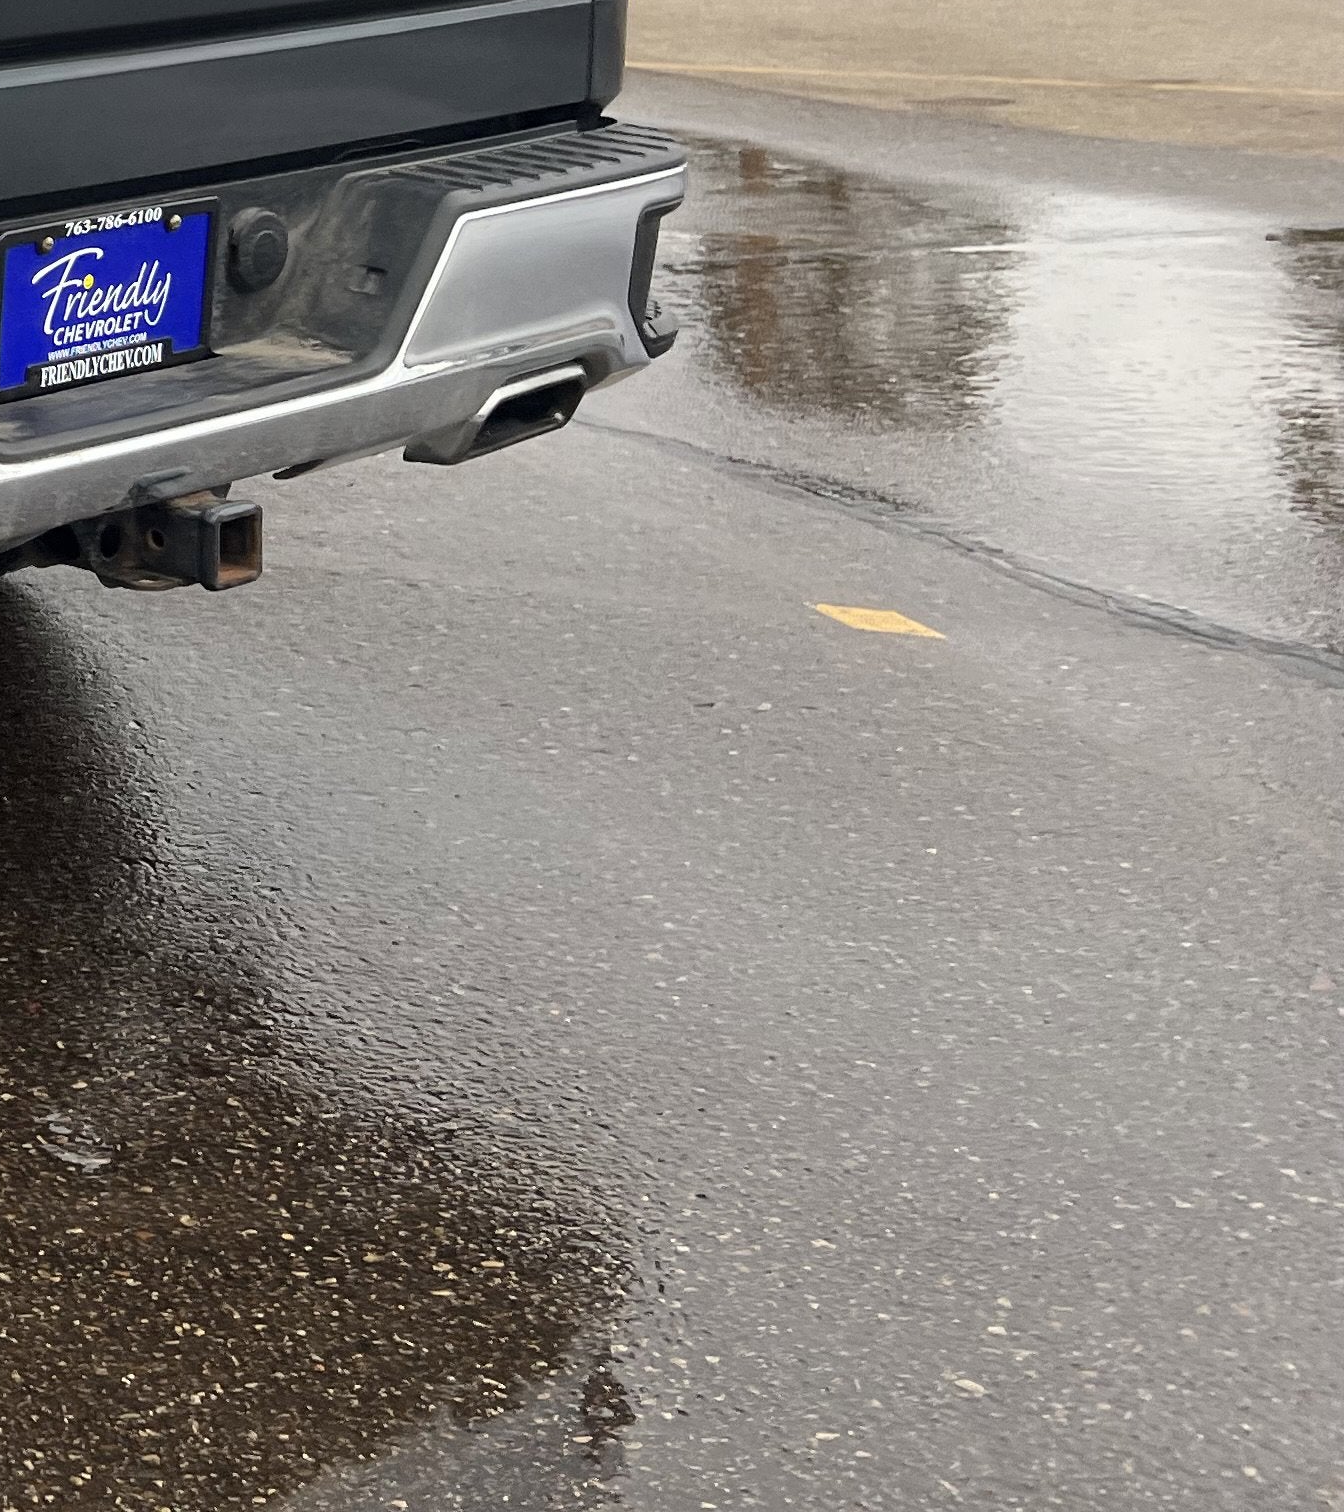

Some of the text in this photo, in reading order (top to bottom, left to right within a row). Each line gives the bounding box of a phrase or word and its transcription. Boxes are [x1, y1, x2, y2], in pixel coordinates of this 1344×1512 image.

[64, 207, 162, 238] 763-786-6100
[31, 247, 172, 335] Friendly
[47, 331, 147, 363] WWW.FRIENDLYCHEV.COM
[52, 310, 141, 347] CHEVROLET
[39, 342, 163, 389] FRIENDLYCHEV.COM
